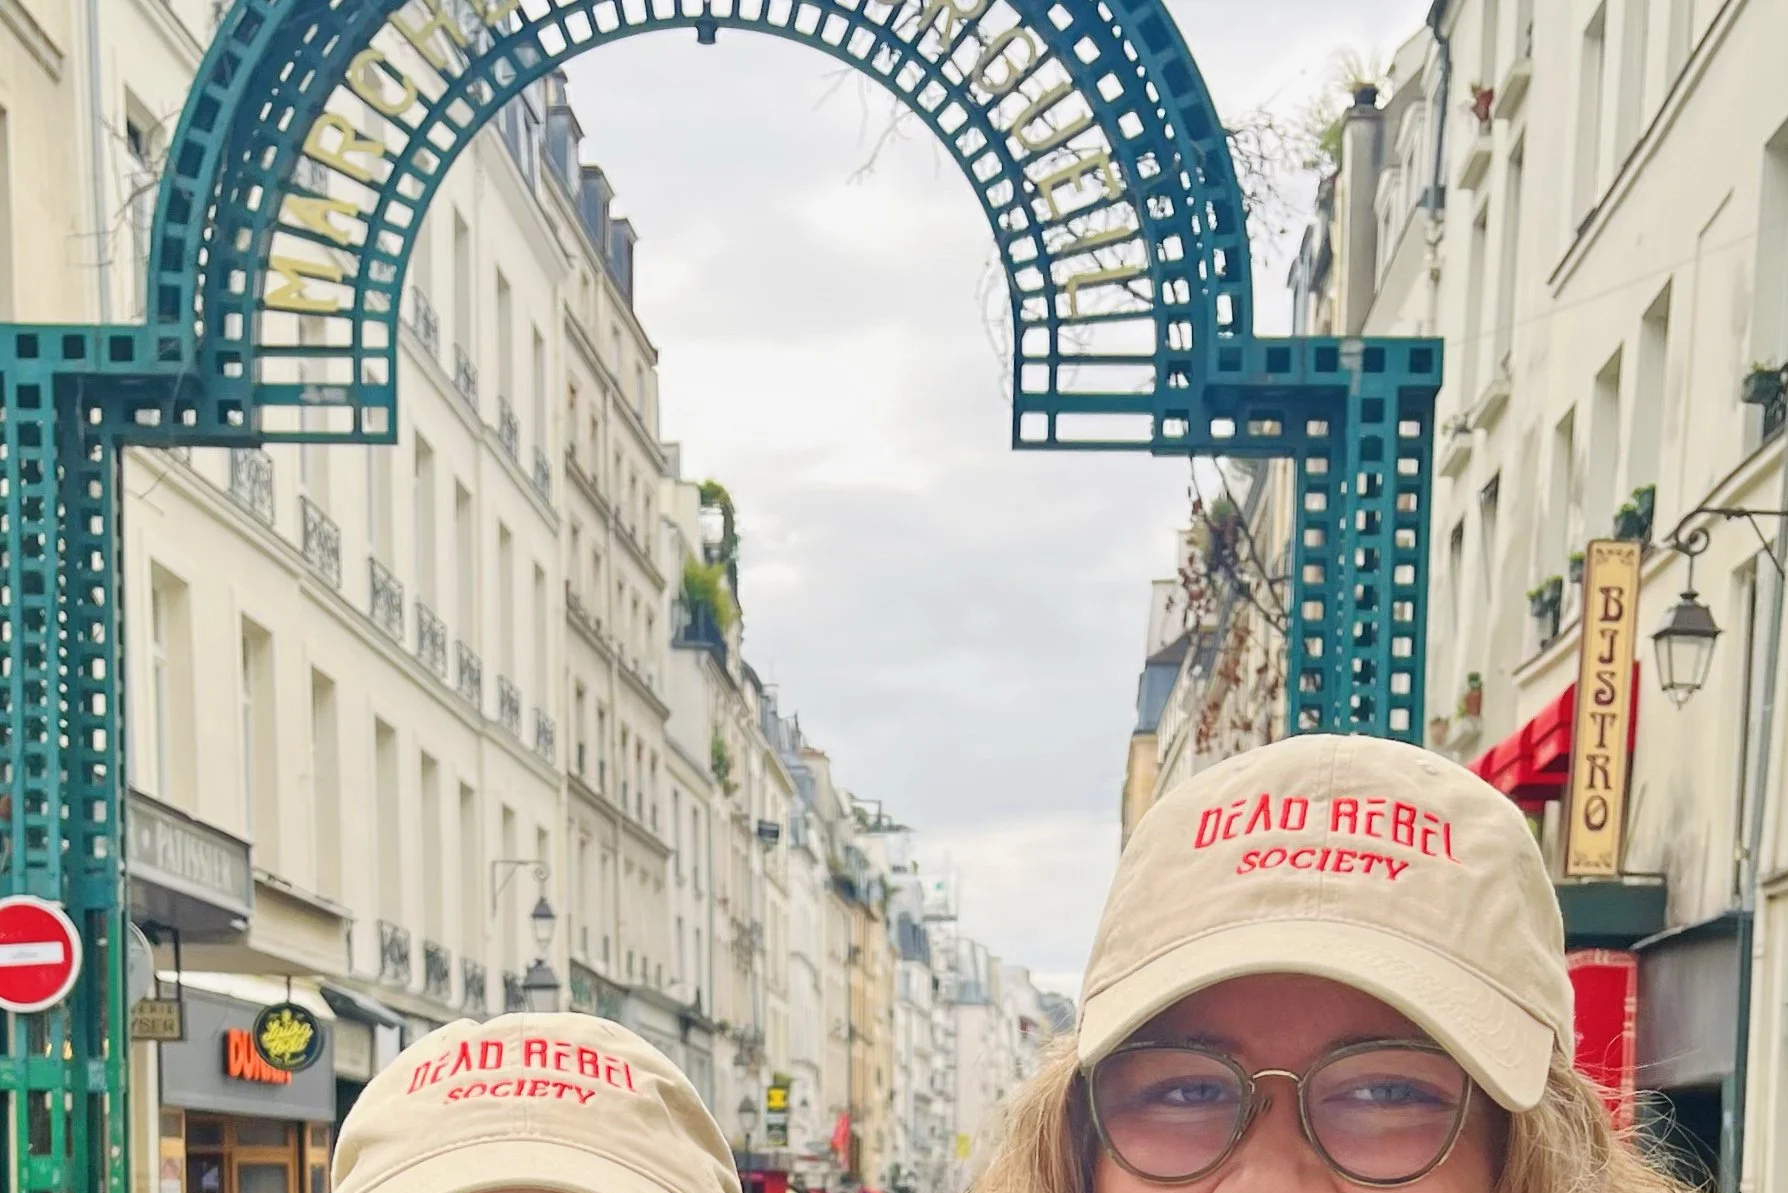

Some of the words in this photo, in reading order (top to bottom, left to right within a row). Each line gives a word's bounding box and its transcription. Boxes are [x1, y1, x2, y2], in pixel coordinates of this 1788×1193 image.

[870, 0, 1142, 319] RGUEIL
[1584, 585, 1625, 832] BISTRO
[1194, 792, 1309, 849] DEAD
[1329, 796, 1462, 864] REBEL
[1235, 847, 1410, 881] SOCIETY
[406, 1040, 504, 1095] DEAD
[523, 1038, 638, 1093] REBEL
[443, 1079, 596, 1105] SOCIETY
